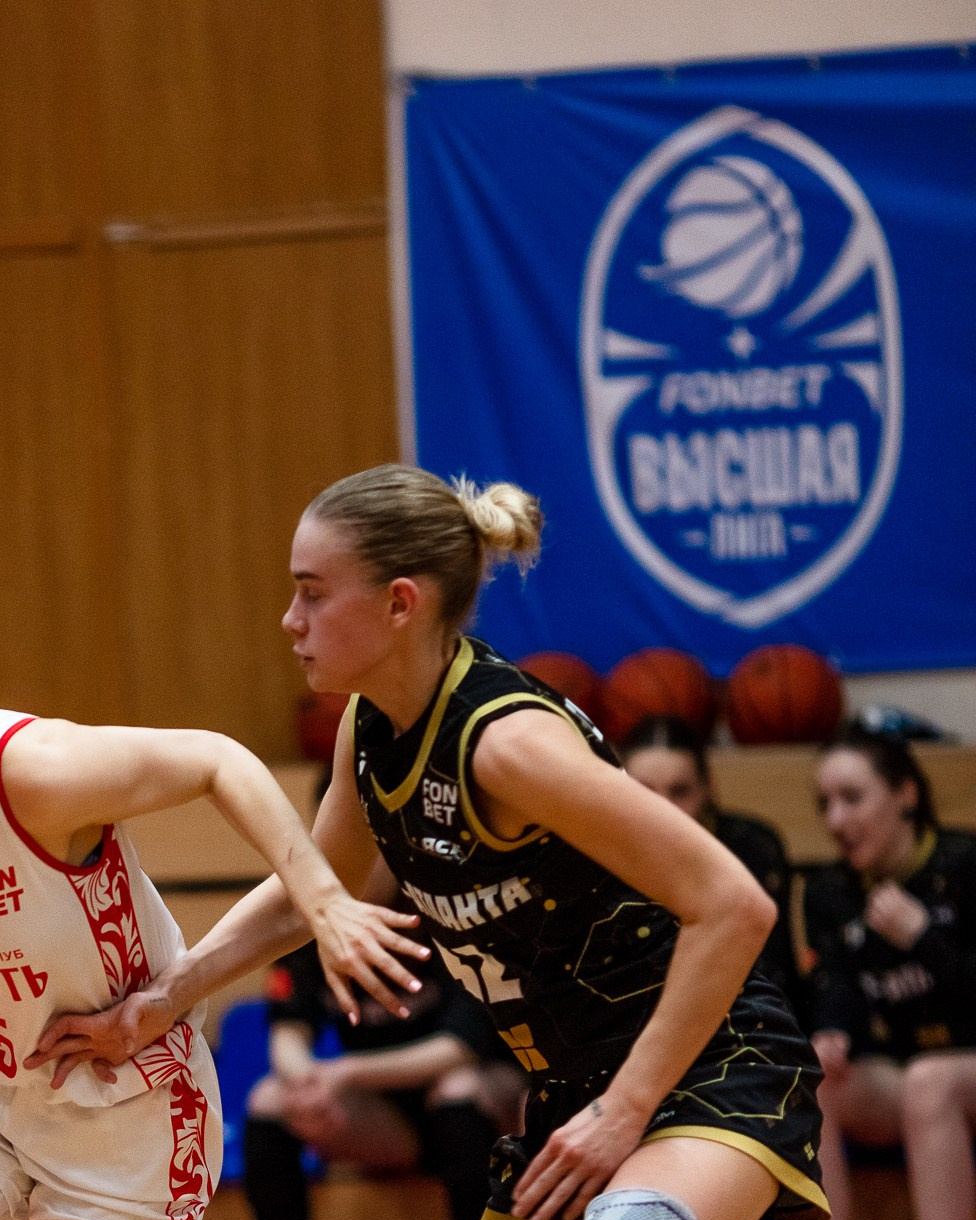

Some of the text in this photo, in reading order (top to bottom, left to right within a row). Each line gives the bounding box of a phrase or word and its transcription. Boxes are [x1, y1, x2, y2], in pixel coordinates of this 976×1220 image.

[659, 364, 831, 415] FONBET
[629, 423, 860, 514] ВЫСШАЯ
[423, 778, 458, 805] FON
[423, 798, 456, 826] BET
